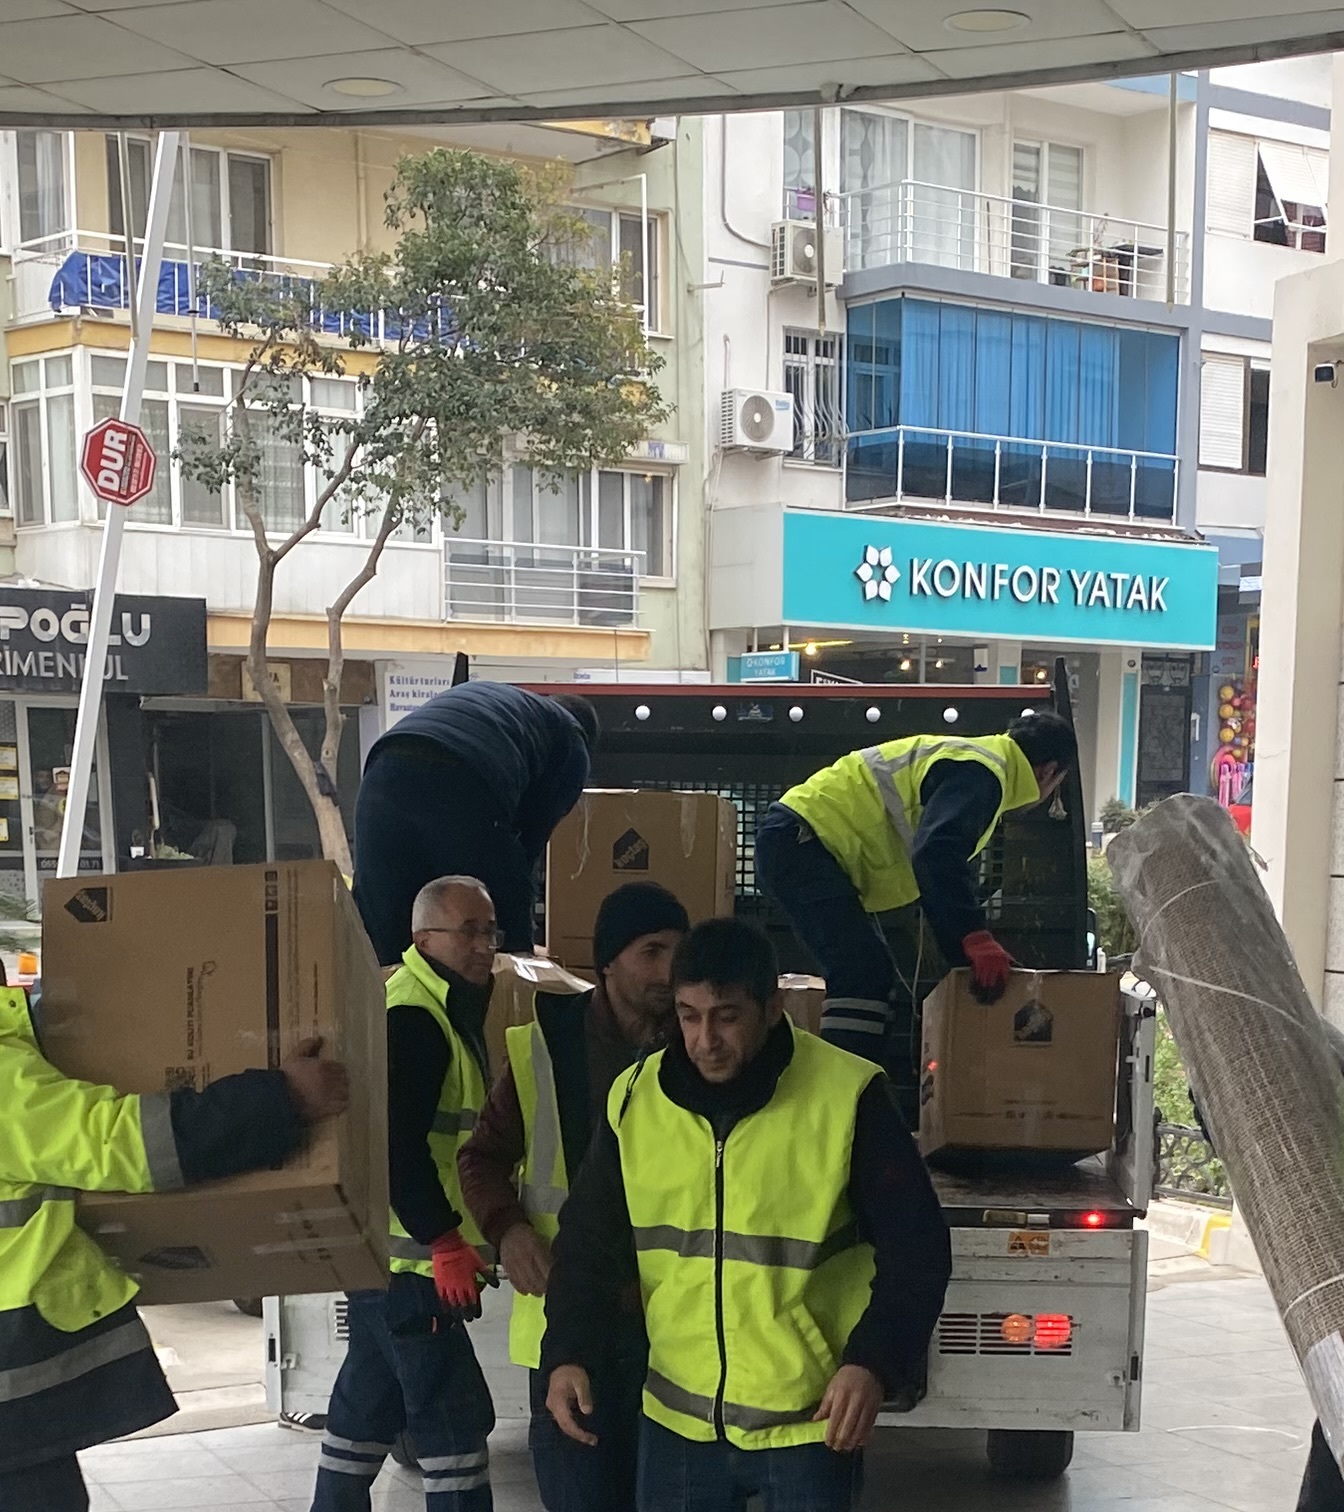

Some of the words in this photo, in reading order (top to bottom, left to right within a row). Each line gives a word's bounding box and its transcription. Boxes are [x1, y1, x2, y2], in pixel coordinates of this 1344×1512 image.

[97, 429, 128, 492] DUR
[910, 557, 1062, 604] KONFOR
[1069, 568, 1171, 612] YATAK
